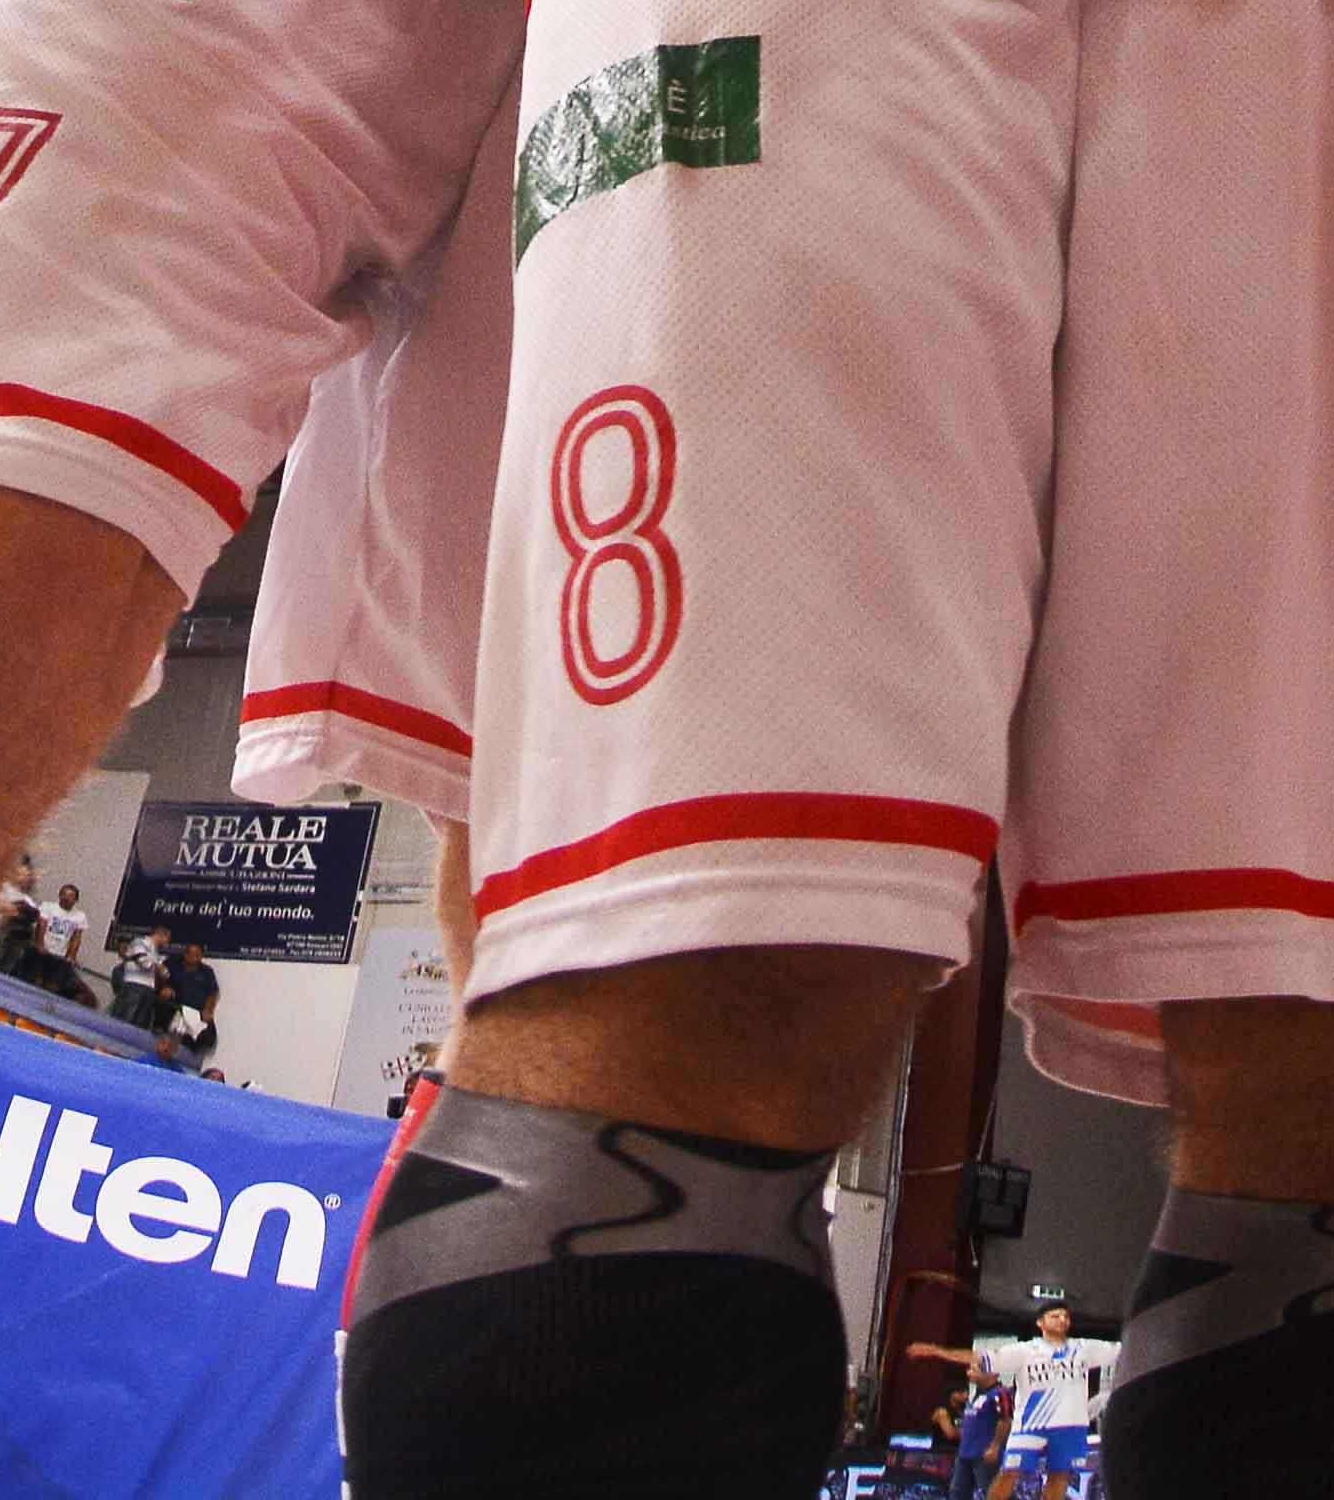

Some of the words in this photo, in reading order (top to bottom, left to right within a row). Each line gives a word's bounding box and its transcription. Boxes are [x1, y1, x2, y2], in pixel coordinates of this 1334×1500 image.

[550, 384, 685, 705] 8
[180, 815, 327, 843] REALE
[173, 842, 318, 870] MUTUA
